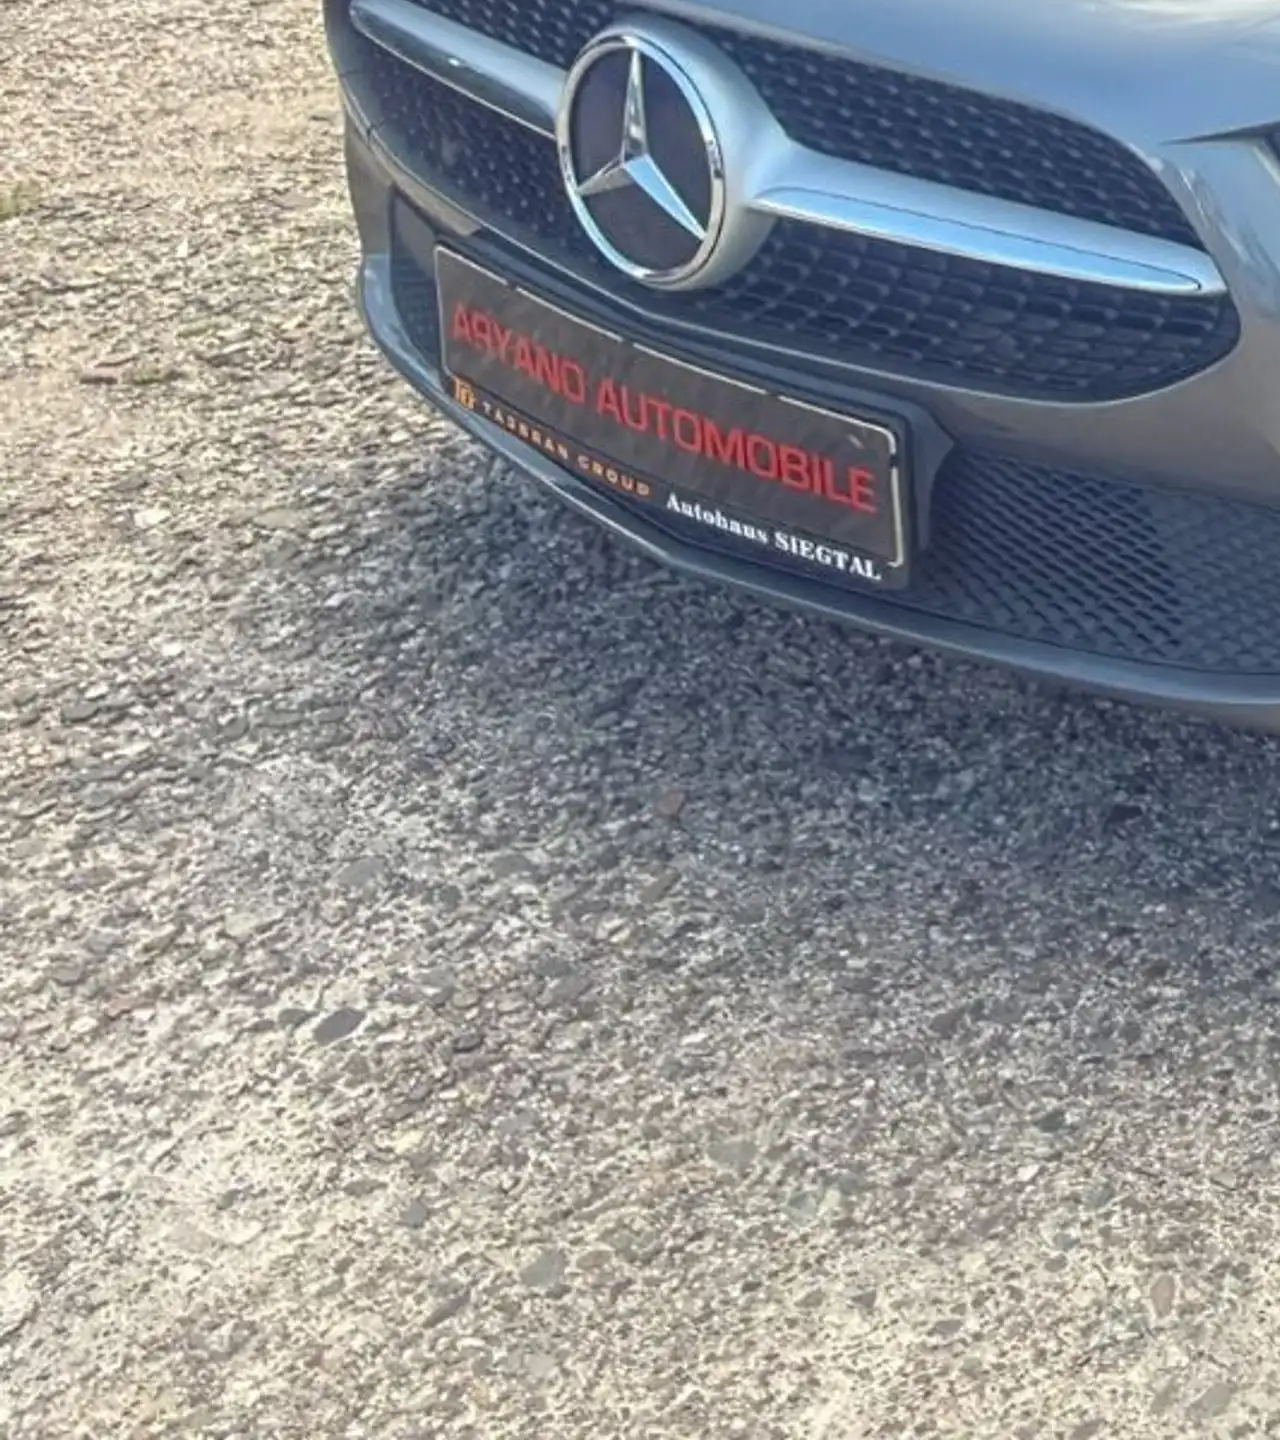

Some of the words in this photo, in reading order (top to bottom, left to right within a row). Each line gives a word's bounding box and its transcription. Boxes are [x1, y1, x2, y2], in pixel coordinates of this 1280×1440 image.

[451, 301, 586, 404] ARYANO
[597, 377, 878, 514] AUTOMOBILE
[666, 491, 769, 545] Autohaus
[774, 530, 882, 581] SIEGTAL
